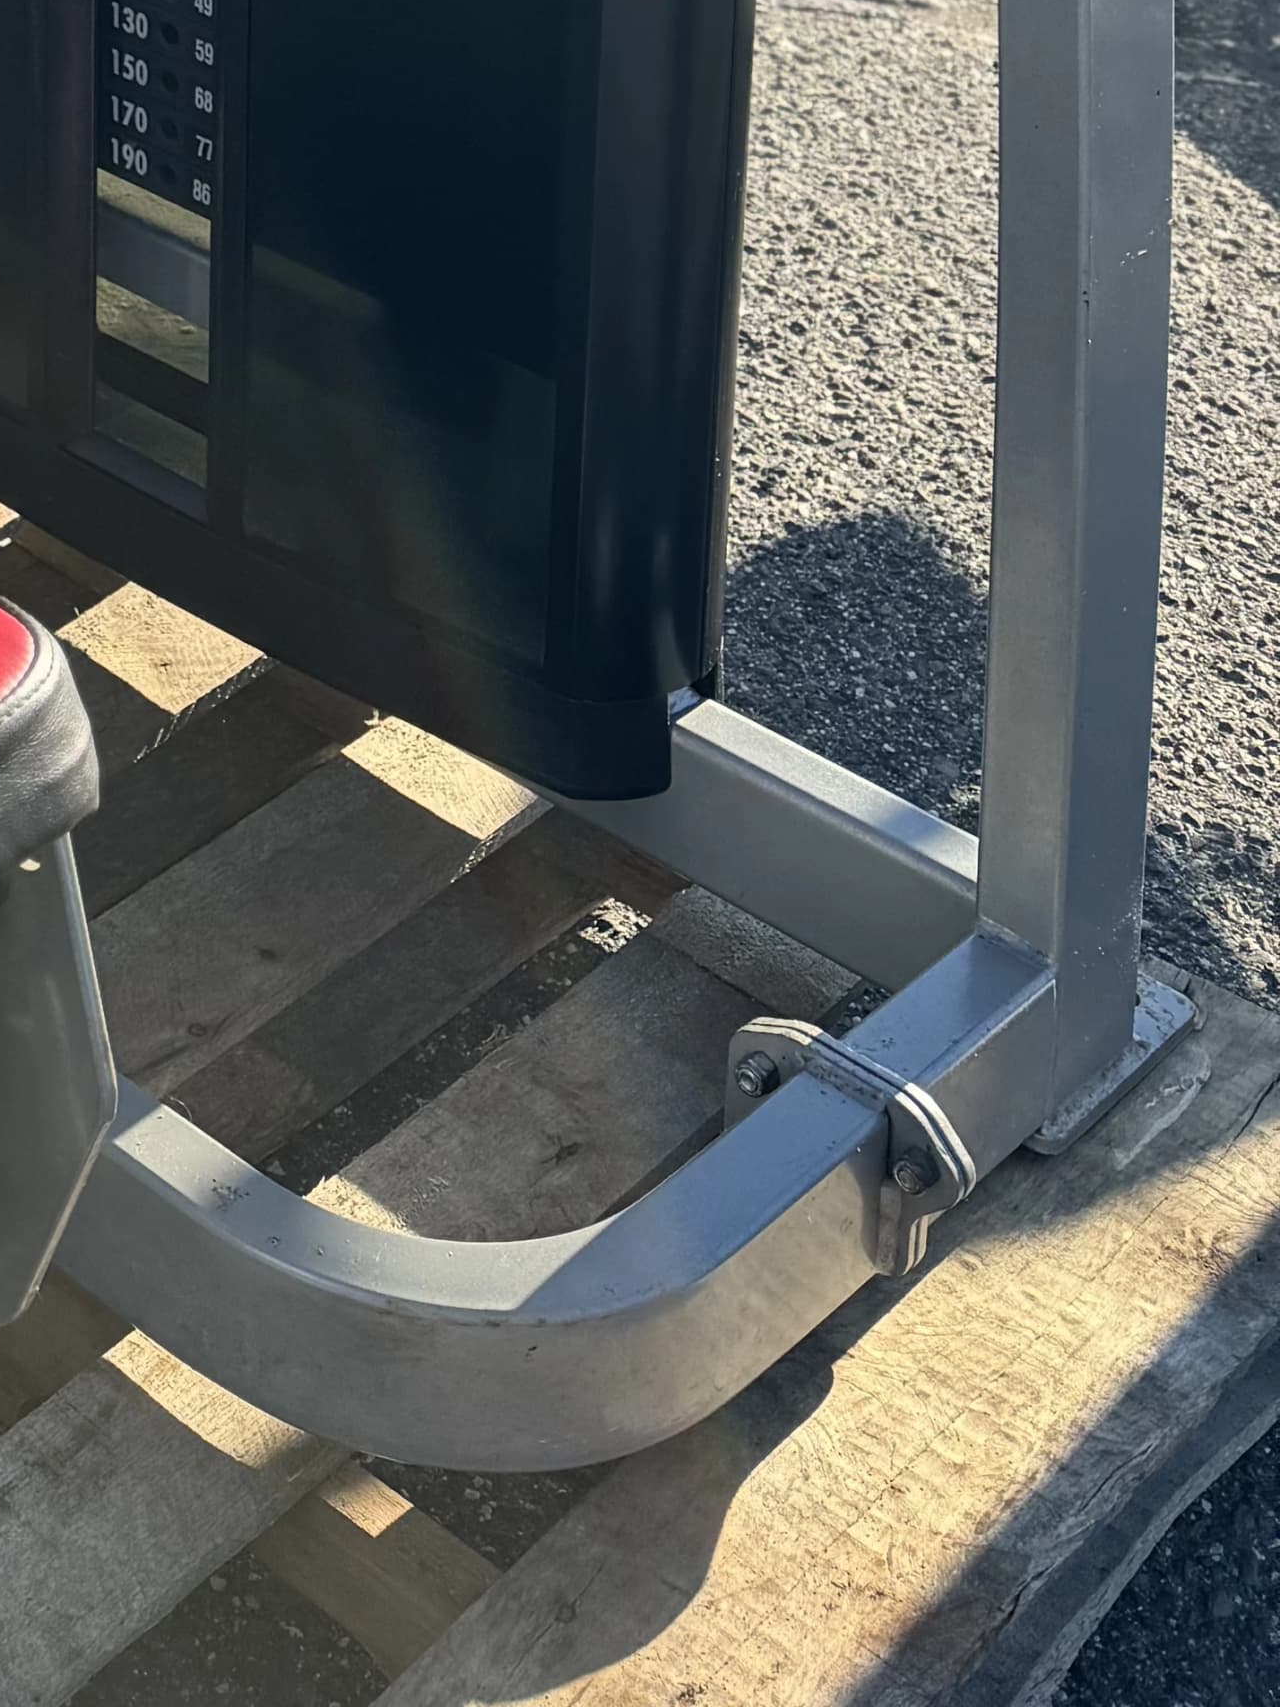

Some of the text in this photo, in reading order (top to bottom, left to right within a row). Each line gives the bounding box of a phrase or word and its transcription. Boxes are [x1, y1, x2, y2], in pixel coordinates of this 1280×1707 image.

[111, 1, 148, 39] 130
[111, 48, 148, 87] 150
[194, 38, 214, 66] 59
[111, 95, 148, 134] 170
[194, 86, 213, 114] 68
[111, 137, 148, 176] 190
[195, 134, 213, 162] 77
[192, 178, 211, 206] 86
